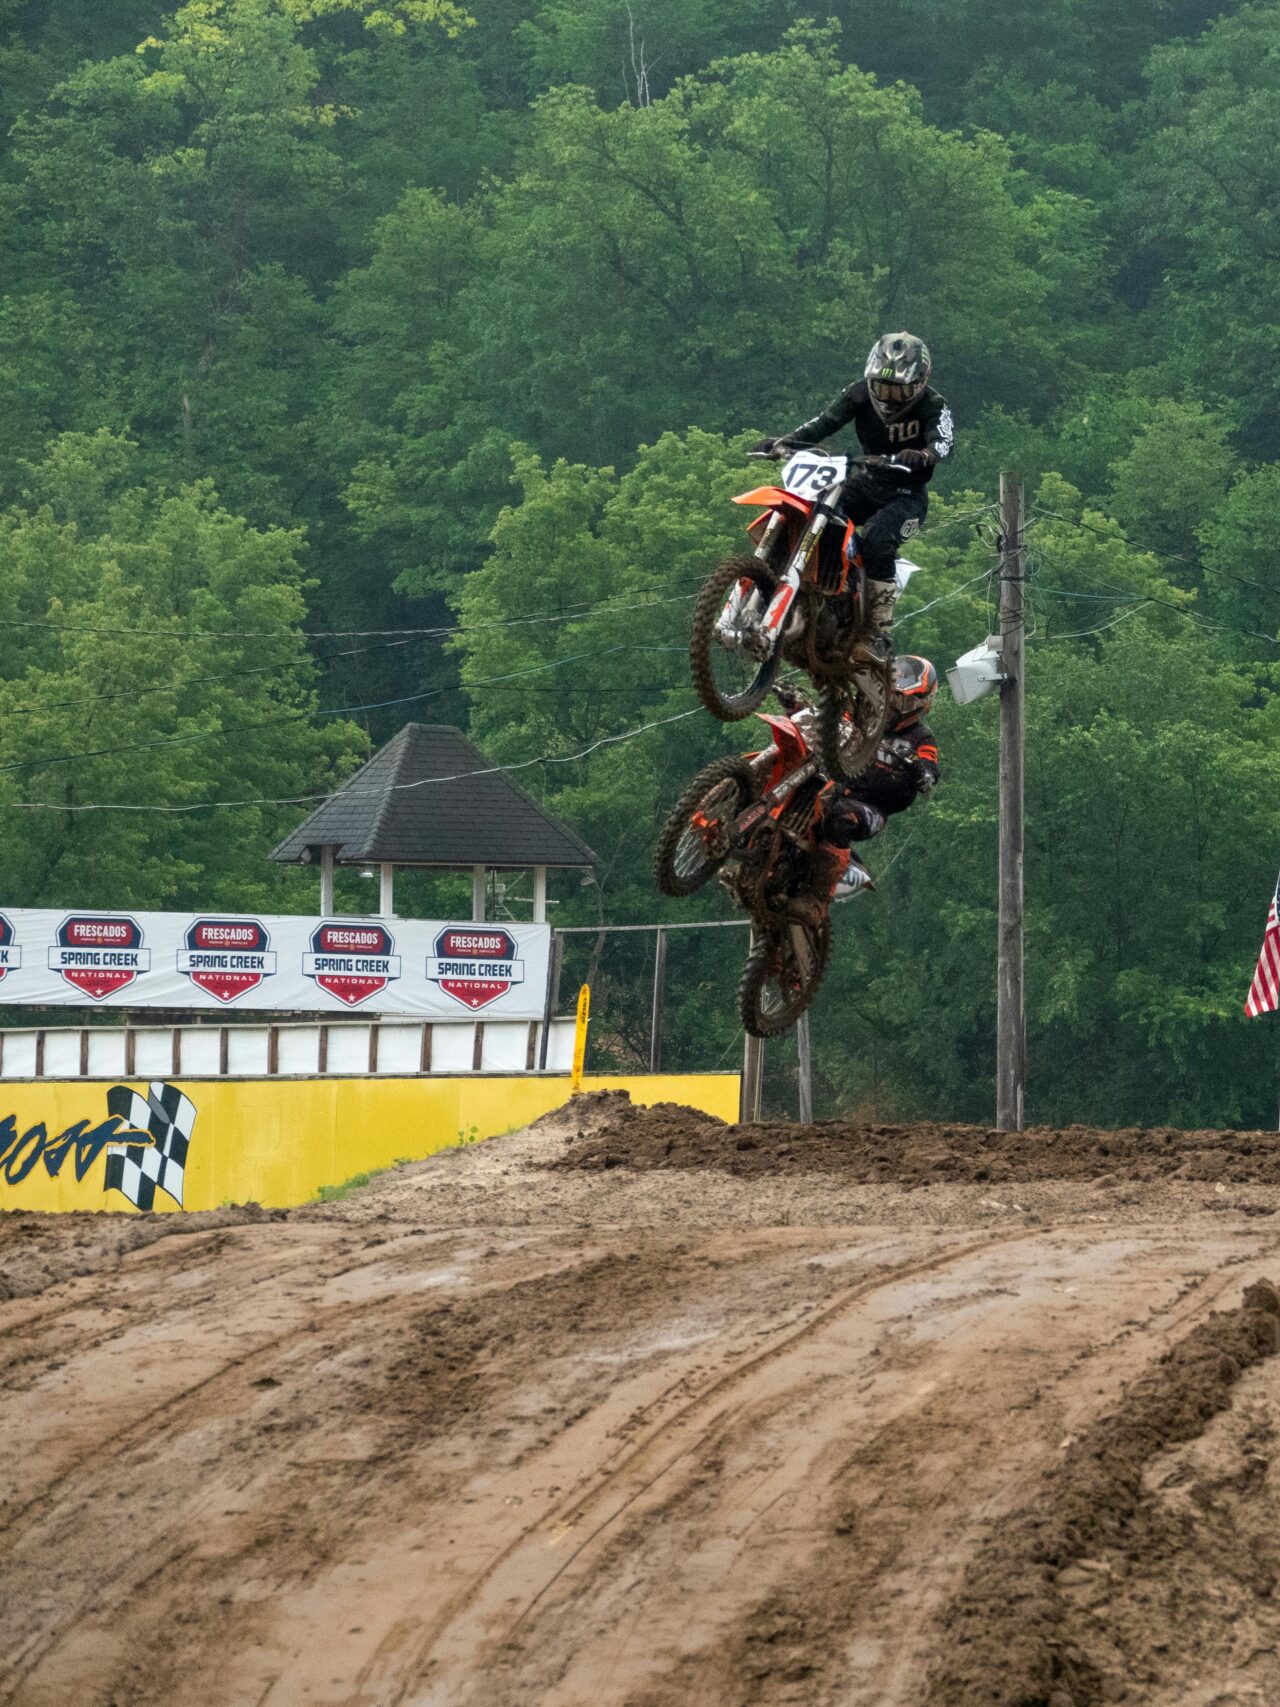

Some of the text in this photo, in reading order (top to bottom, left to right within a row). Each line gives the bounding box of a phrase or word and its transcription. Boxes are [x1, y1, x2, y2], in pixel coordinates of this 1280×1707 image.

[785, 463, 838, 491] 173
[74, 925, 127, 937] FRESCADOS
[202, 927, 253, 941] FRESCADOS
[327, 931, 378, 945] FRESCADOS
[450, 936, 501, 949] FRESCADOS
[60, 951, 138, 967] SPRING CREEK
[189, 954, 265, 969] SPRING CREEK
[314, 958, 389, 973] SPRING CREEK
[71, 971, 128, 979] NATIONAL
[438, 962, 512, 978] SPRING CREEK
[199, 974, 254, 982] NATIONAL
[324, 977, 380, 985] NATIONAL
[448, 981, 502, 989] NATIONAL
